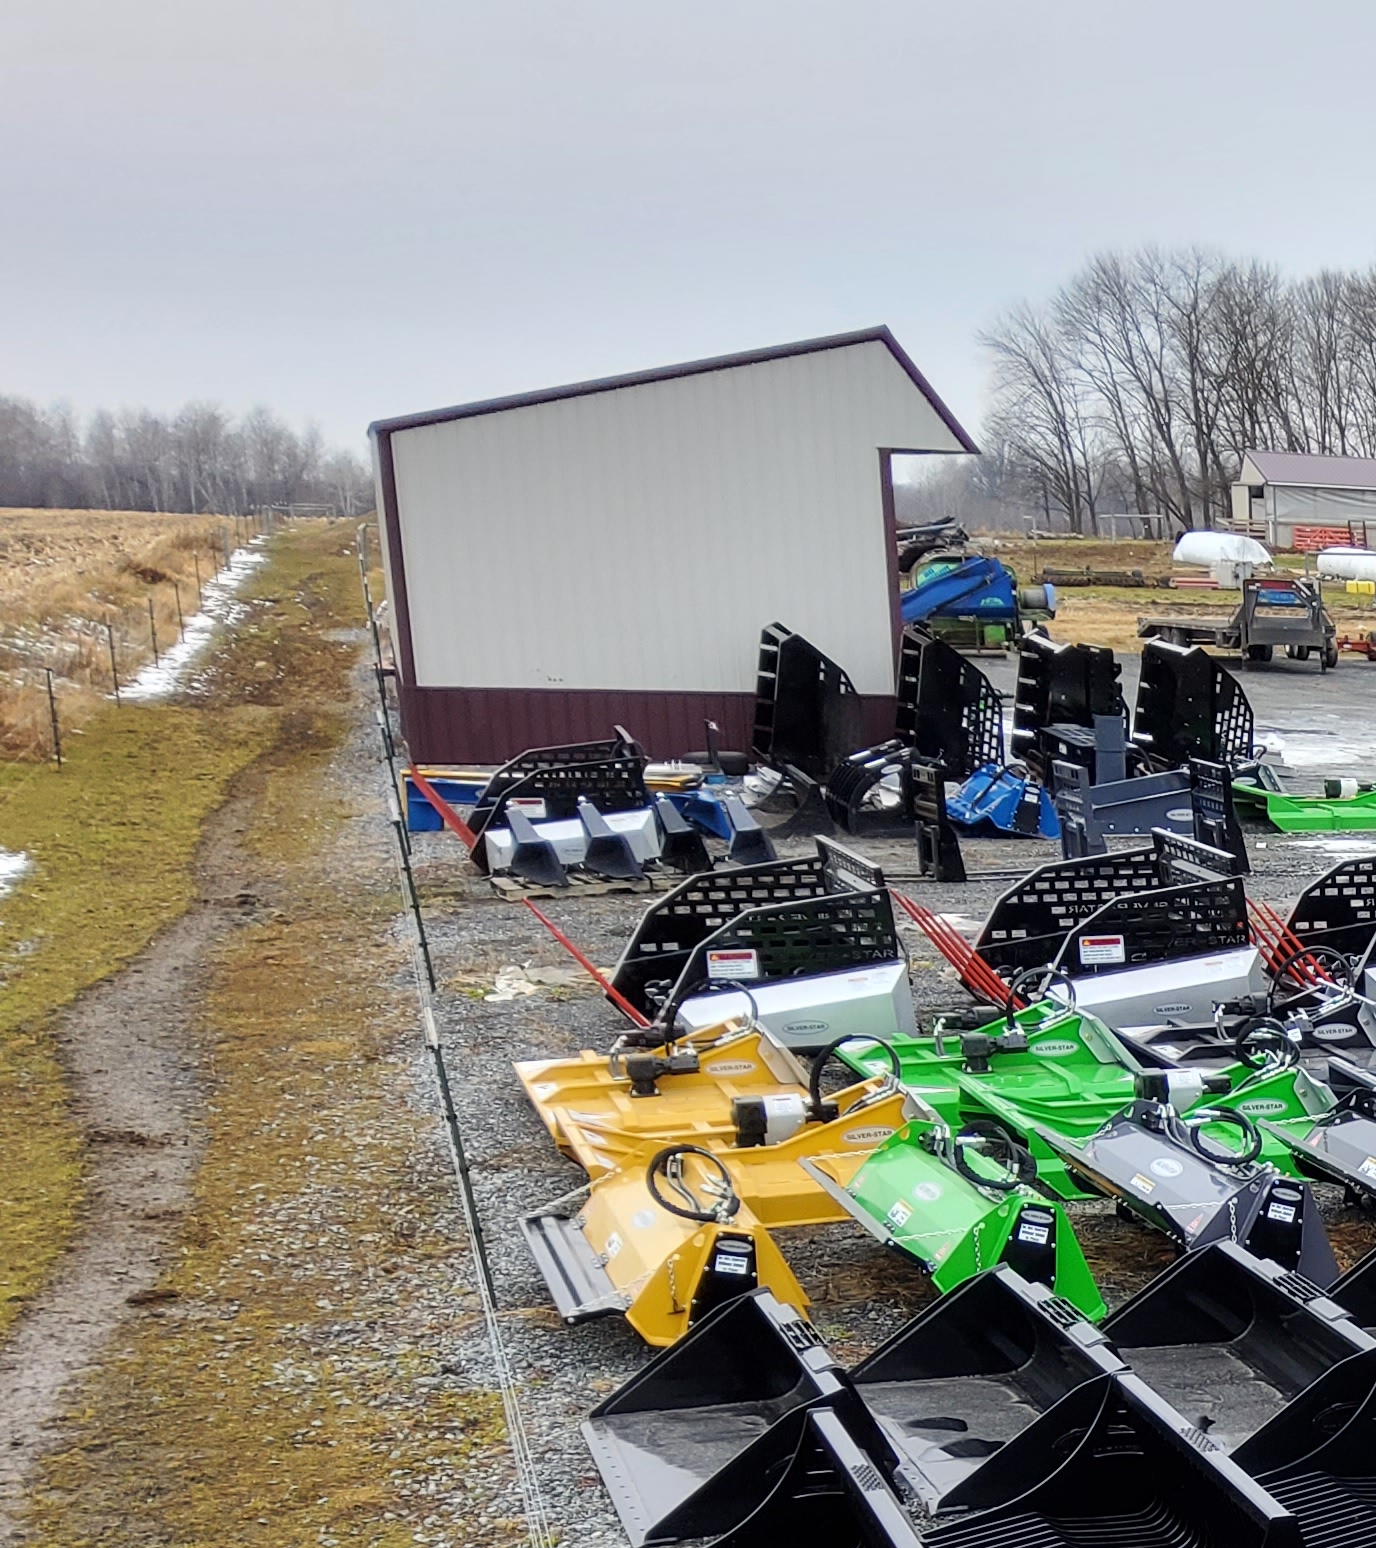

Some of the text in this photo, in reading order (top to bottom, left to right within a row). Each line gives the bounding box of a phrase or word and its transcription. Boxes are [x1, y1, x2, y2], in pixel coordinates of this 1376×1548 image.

[1155, 1005, 1190, 1013] SILVER-STAR
[786, 1023, 825, 1032] SILVER-STAR
[1317, 1027, 1353, 1035] SILVER-STAR
[1035, 1044, 1075, 1052] SILVER-STAR
[709, 1064, 752, 1072] SILVER-STAR
[1242, 1103, 1283, 1111] SILVER-STAR
[846, 1130, 892, 1140] SILVER-STAR
